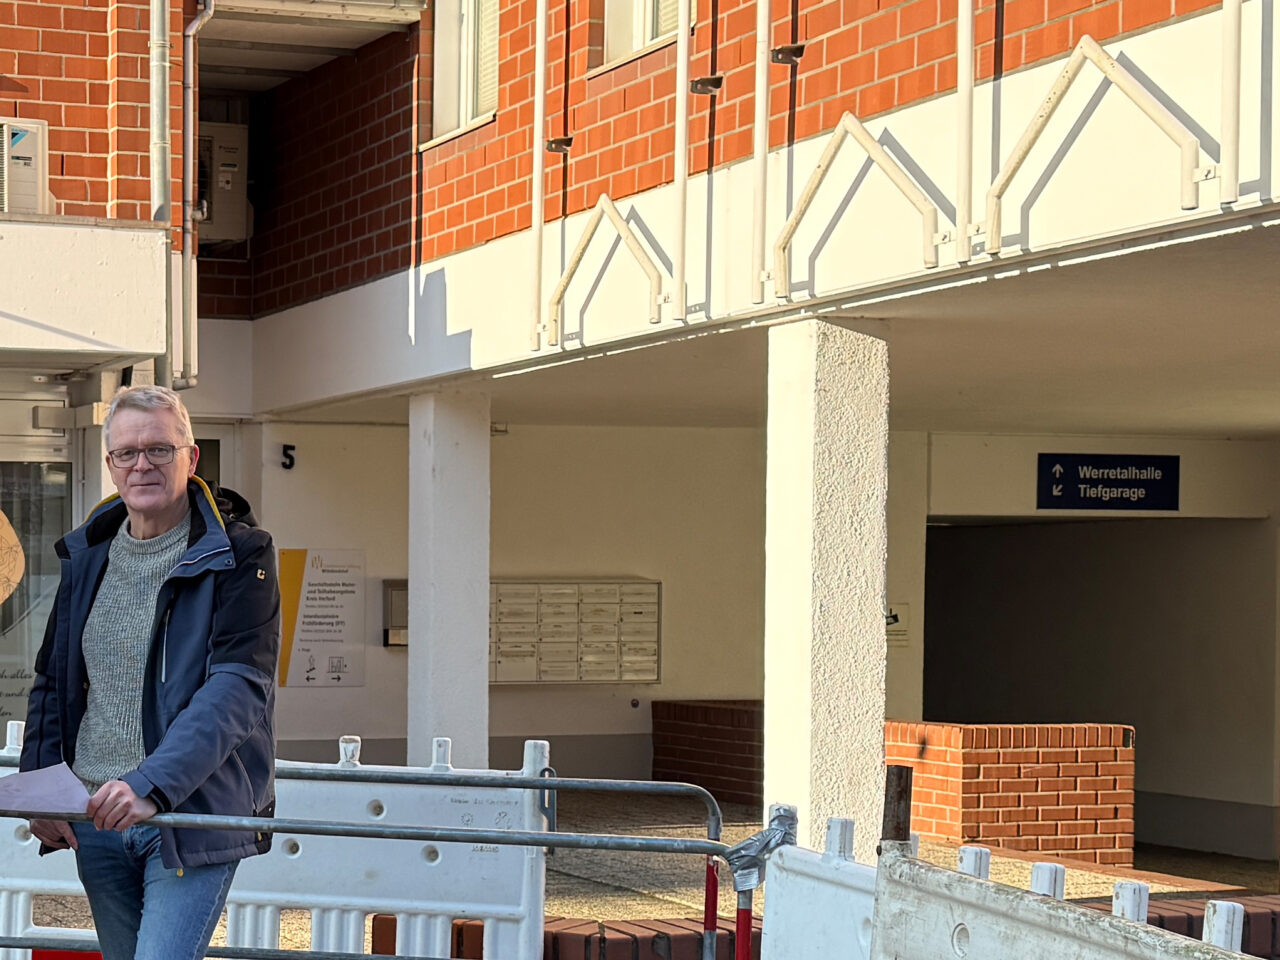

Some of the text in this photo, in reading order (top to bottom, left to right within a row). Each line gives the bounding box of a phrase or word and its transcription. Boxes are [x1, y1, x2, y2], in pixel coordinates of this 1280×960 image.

[281, 444, 296, 470] 5
[1078, 465, 1163, 480] Werretalhalle
[1078, 484, 1146, 501] Tiefgarage
